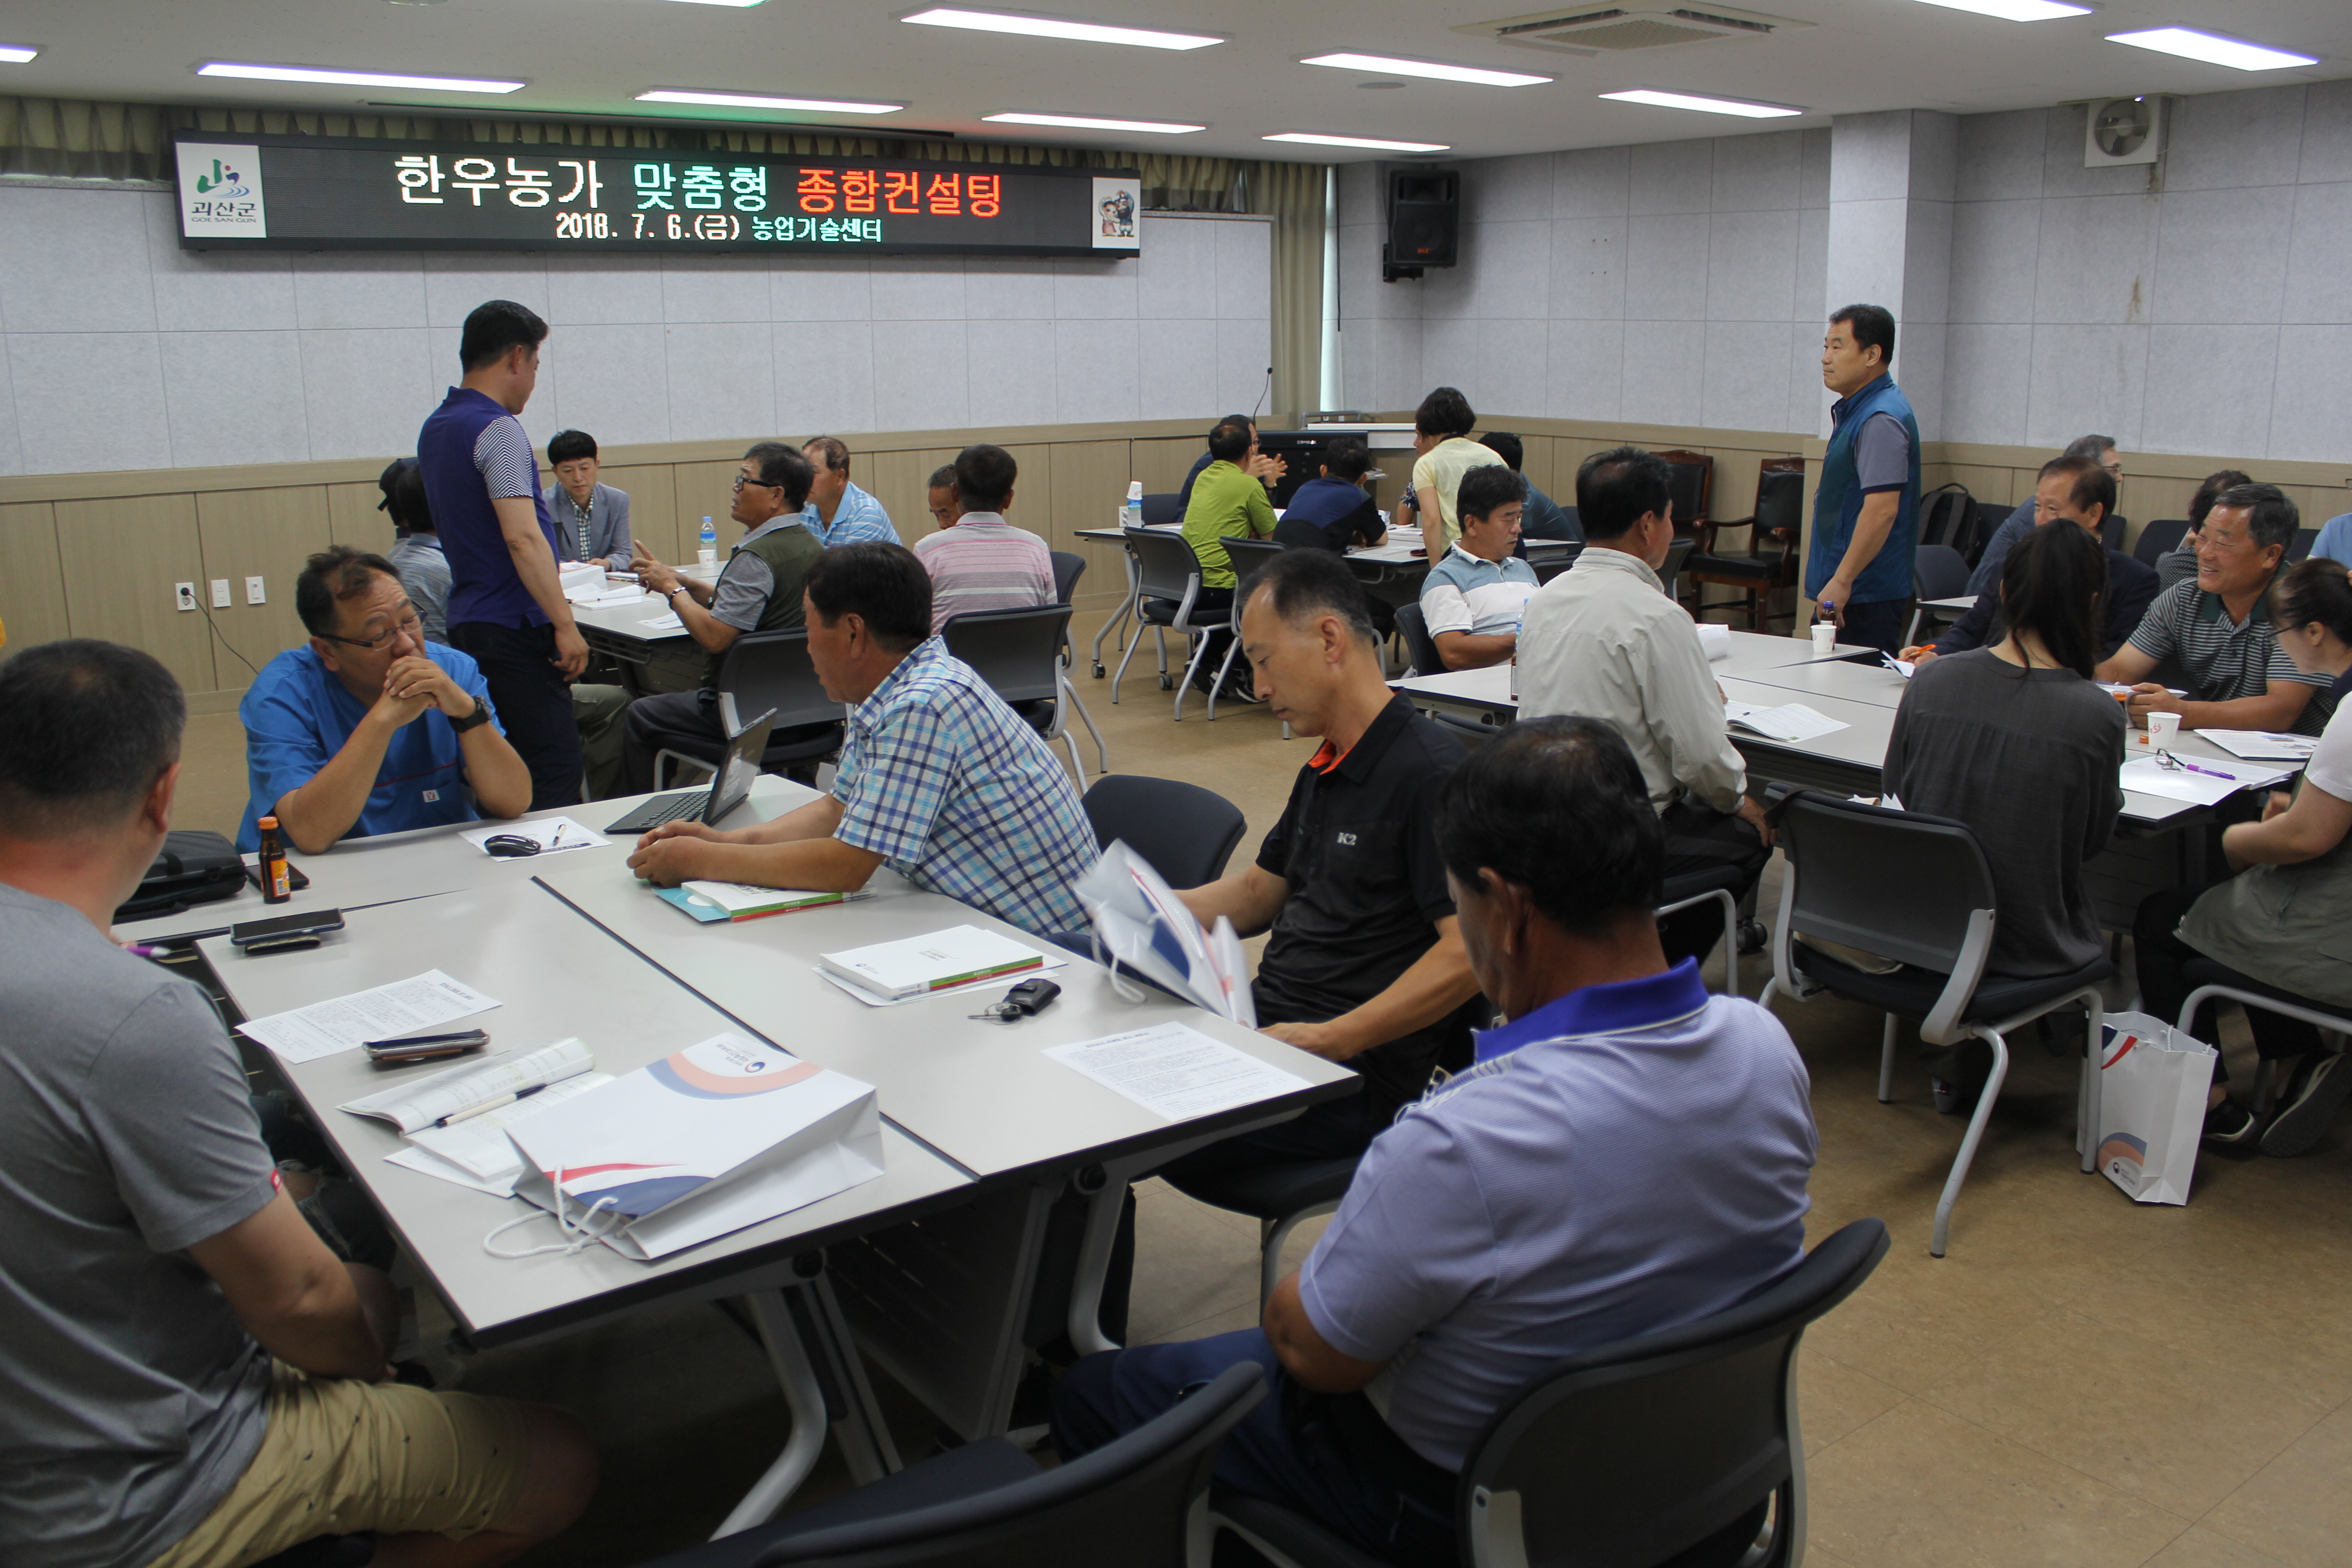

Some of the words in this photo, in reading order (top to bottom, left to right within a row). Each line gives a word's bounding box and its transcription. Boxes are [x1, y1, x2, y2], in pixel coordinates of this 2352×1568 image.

[395, 155, 604, 209] 한우농가
[634, 163, 767, 213] 맞춤형
[798, 168, 1001, 217] 종합컨설팅
[191, 202, 257, 217] 괴산군
[555, 211, 618, 239] 2018.
[631, 213, 655, 239] 7.
[751, 216, 882, 242] 농업기술센터
[1337, 832, 1357, 846] K2
